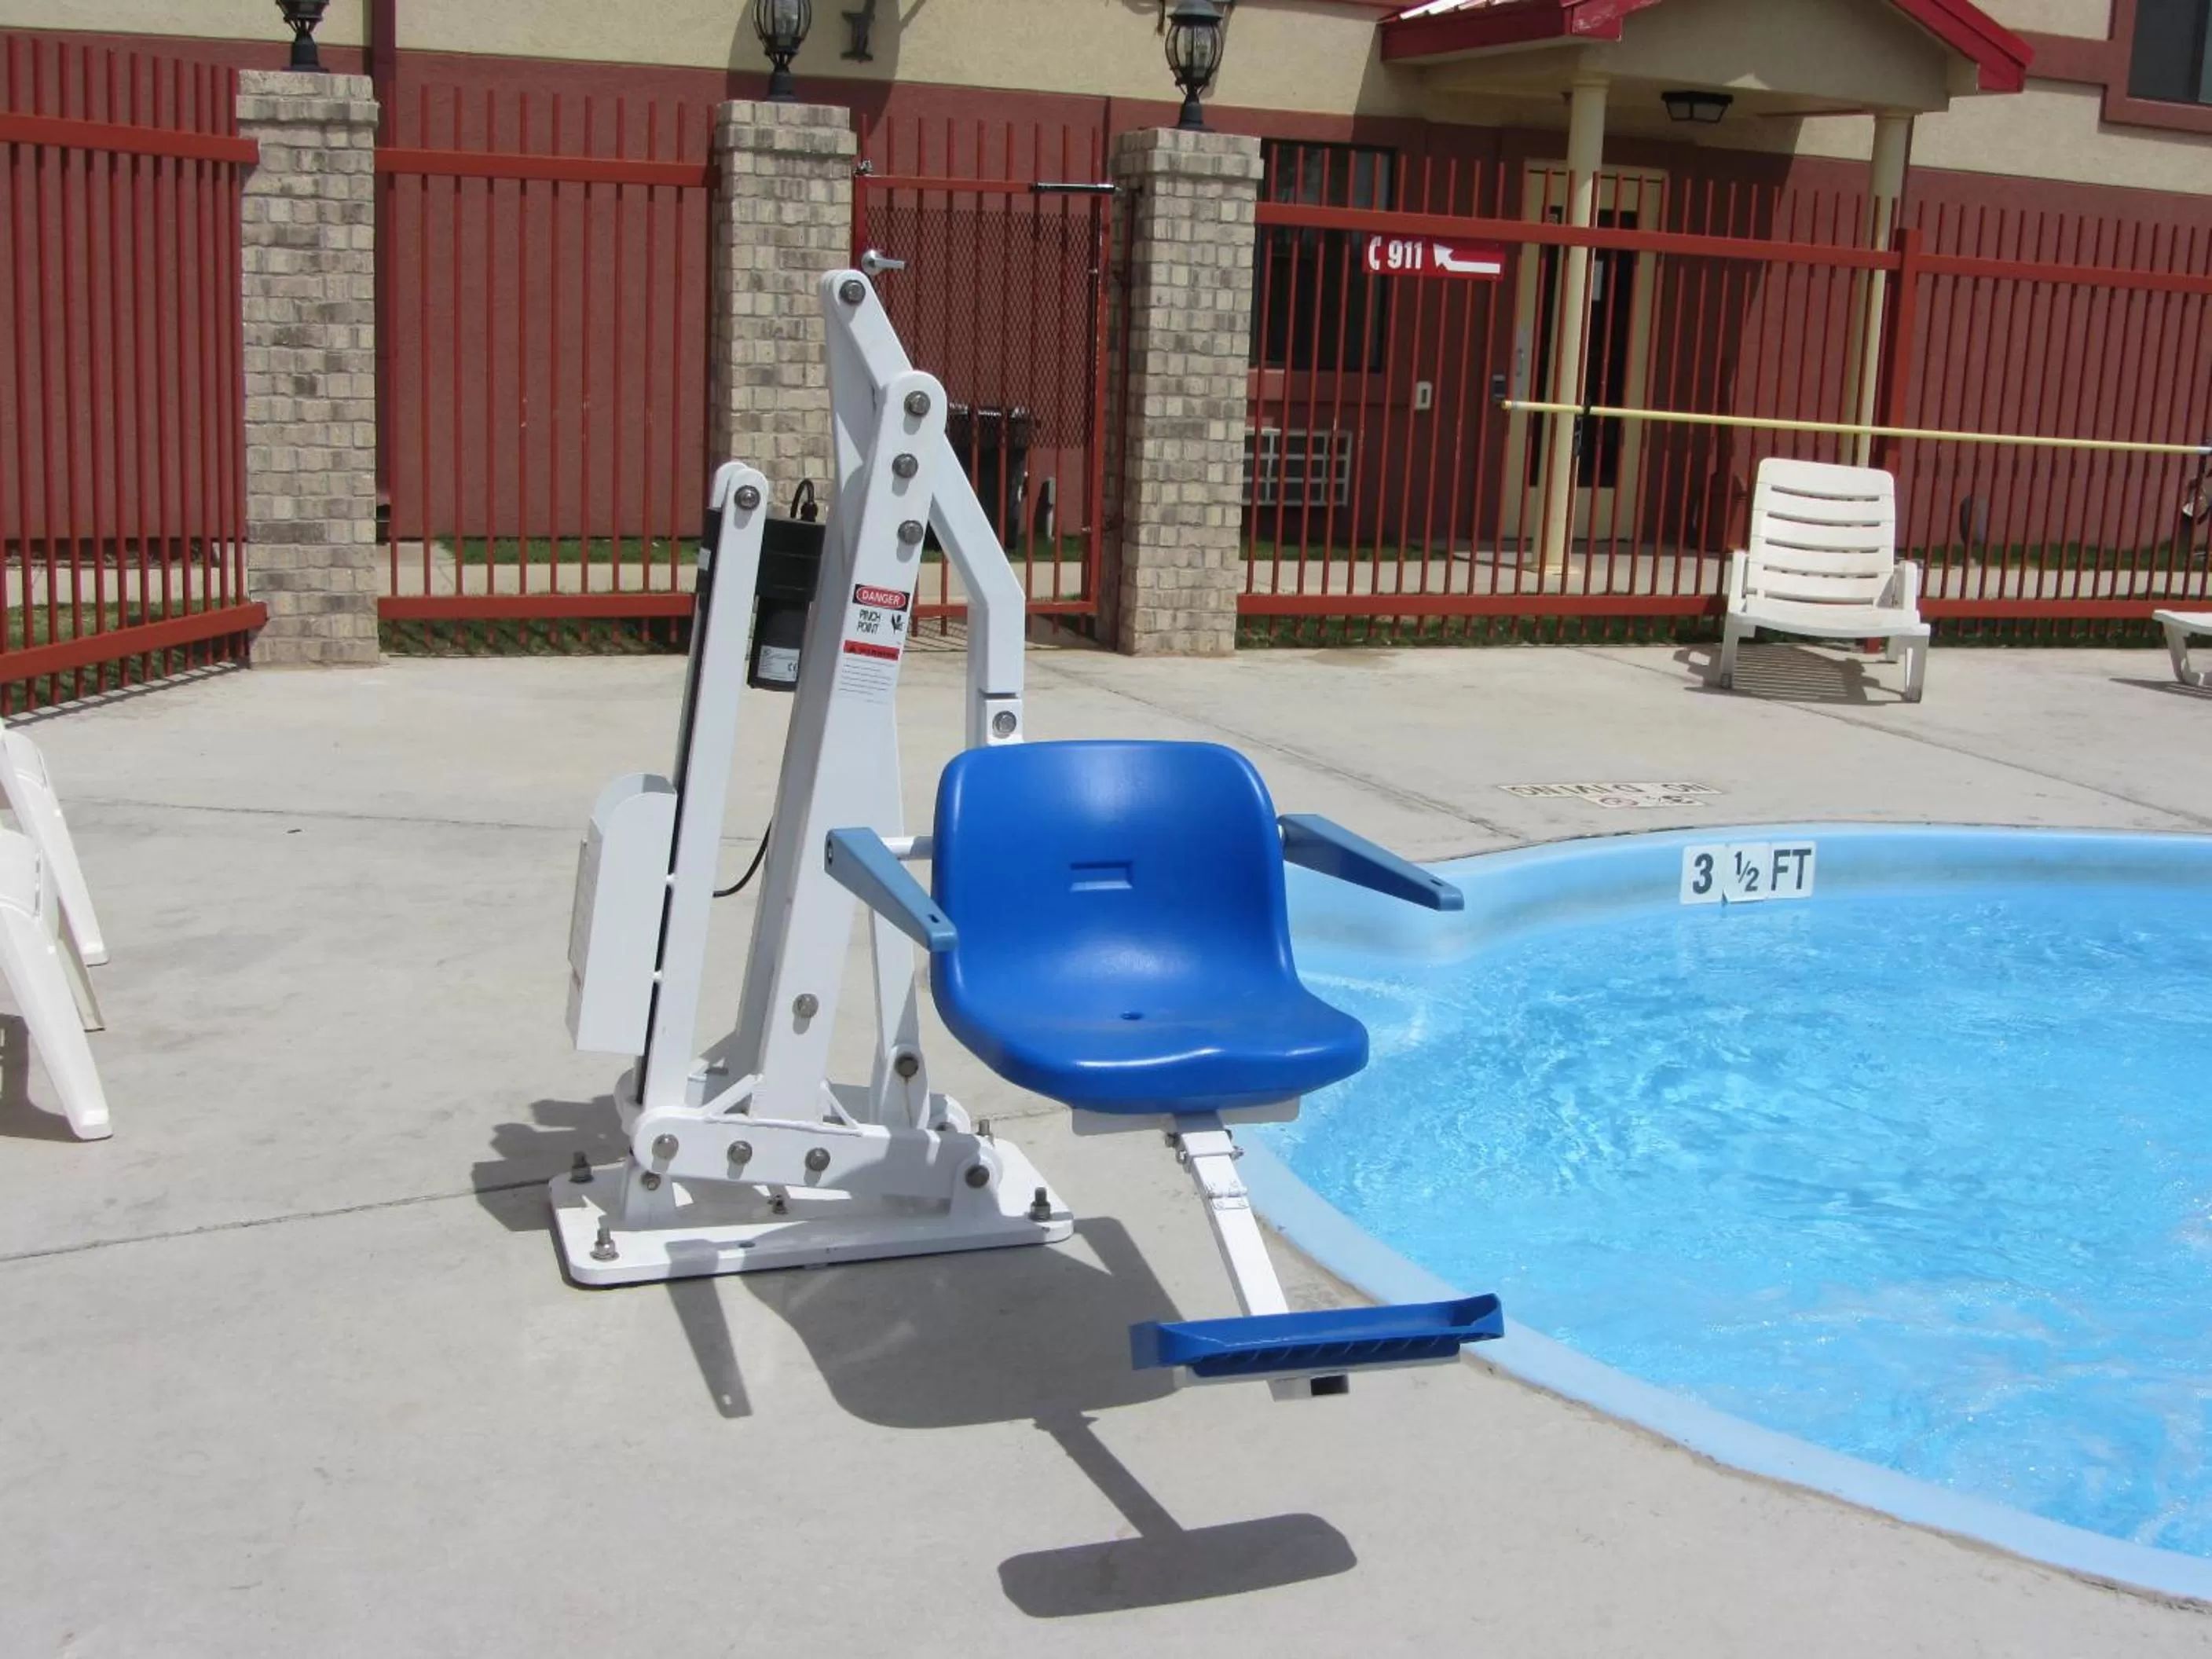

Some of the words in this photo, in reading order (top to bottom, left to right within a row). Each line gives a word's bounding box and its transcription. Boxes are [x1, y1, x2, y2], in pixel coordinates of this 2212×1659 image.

[1387, 239, 1423, 269] 911
[862, 589, 900, 606] DANGER
[859, 609, 881, 622] PINCH
[857, 621, 879, 635] POINT
[1692, 852, 1714, 894] 3
[1771, 848, 1812, 891] FT
